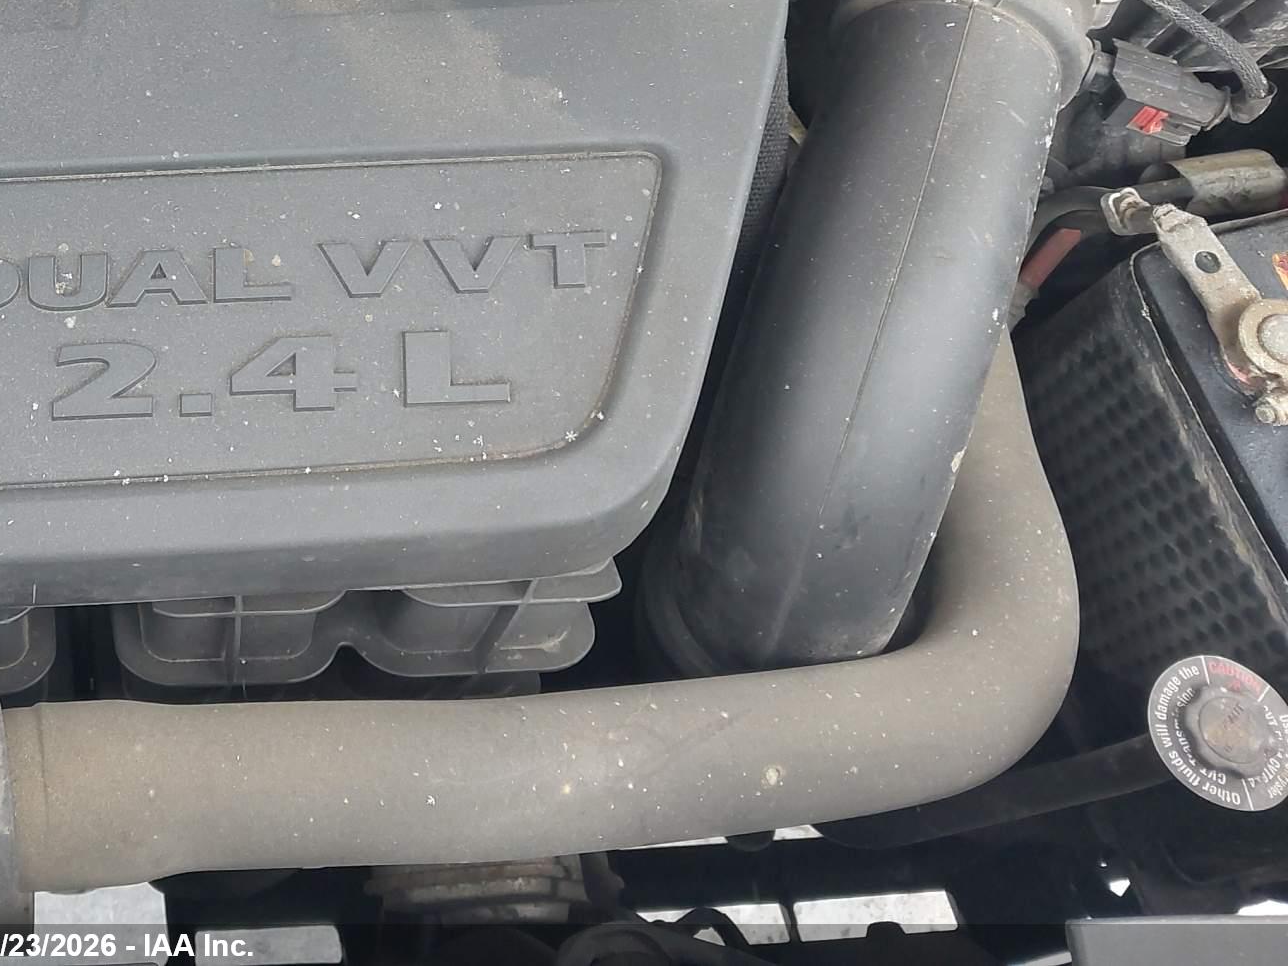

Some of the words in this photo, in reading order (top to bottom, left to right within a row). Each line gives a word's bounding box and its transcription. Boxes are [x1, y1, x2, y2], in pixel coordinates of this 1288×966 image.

[318, 230, 608, 299] VVT
[1179, 664, 1200, 680] the
[1155, 676, 1182, 720] damage
[1155, 723, 1173, 748] will
[1168, 750, 1201, 786] fluids
[1202, 786, 1241, 805] Other
